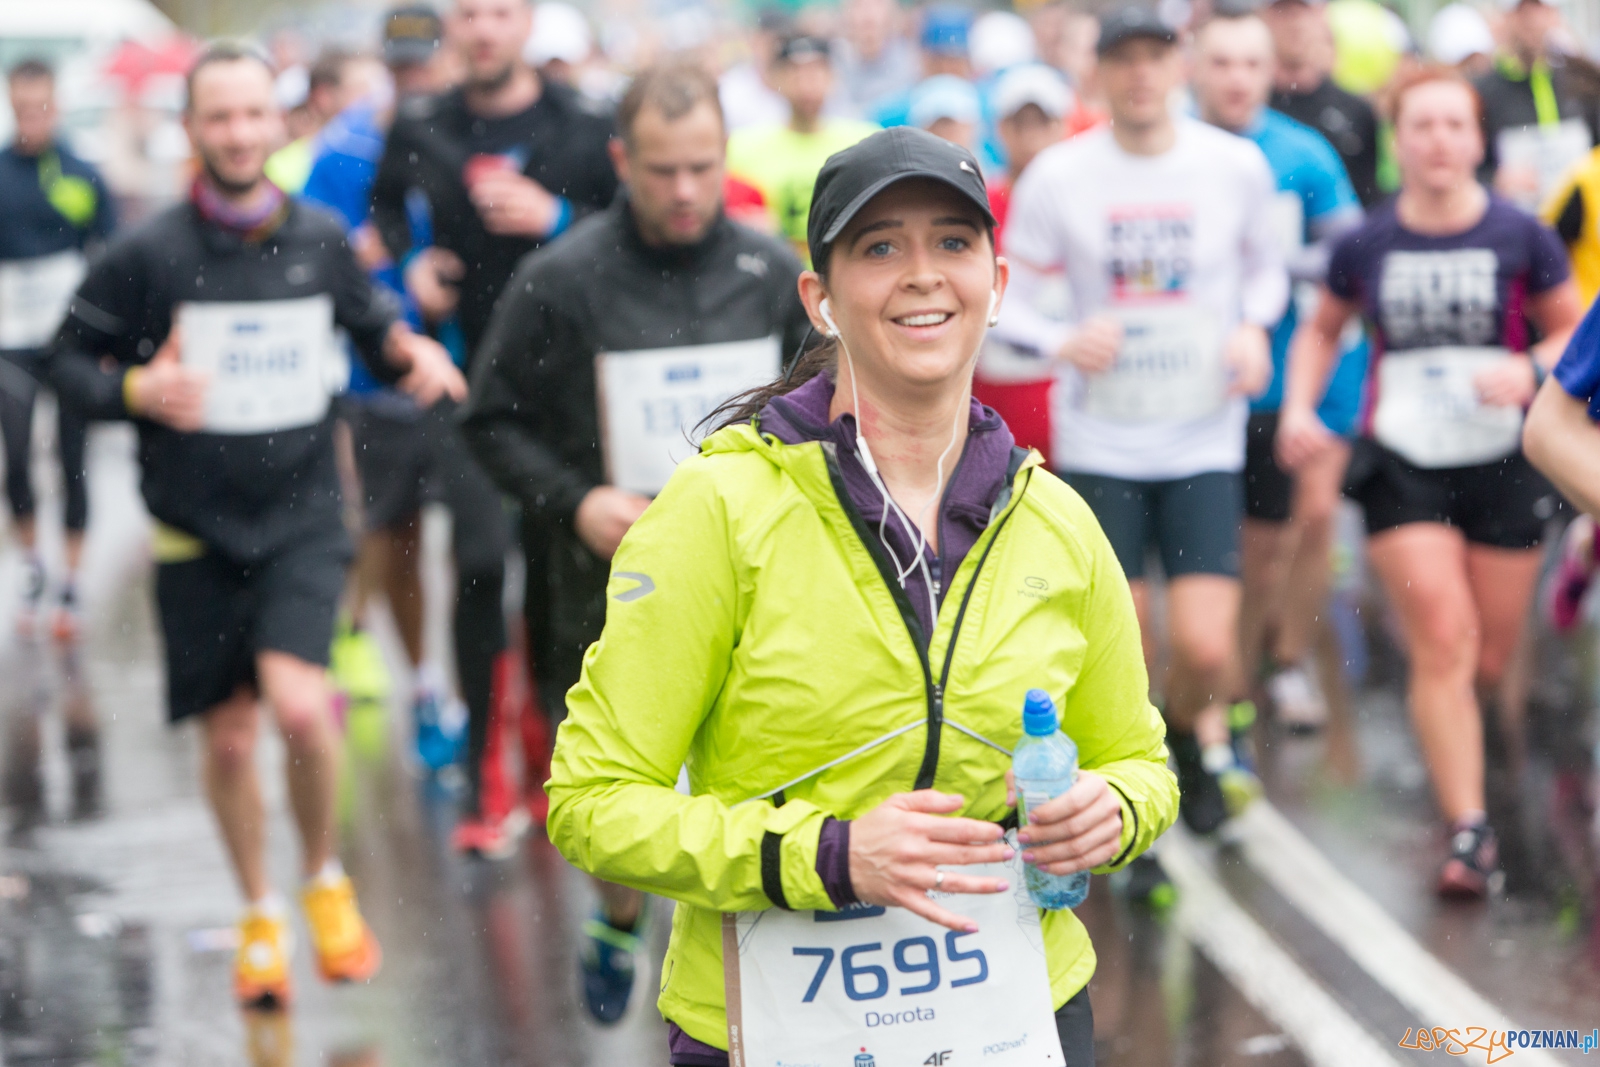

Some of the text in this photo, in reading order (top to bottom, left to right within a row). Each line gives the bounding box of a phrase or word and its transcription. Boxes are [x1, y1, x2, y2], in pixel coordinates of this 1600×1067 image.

[792, 930, 989, 1003] 7695
[865, 1008, 936, 1027] Dorota
[923, 1050, 953, 1066] 4F
